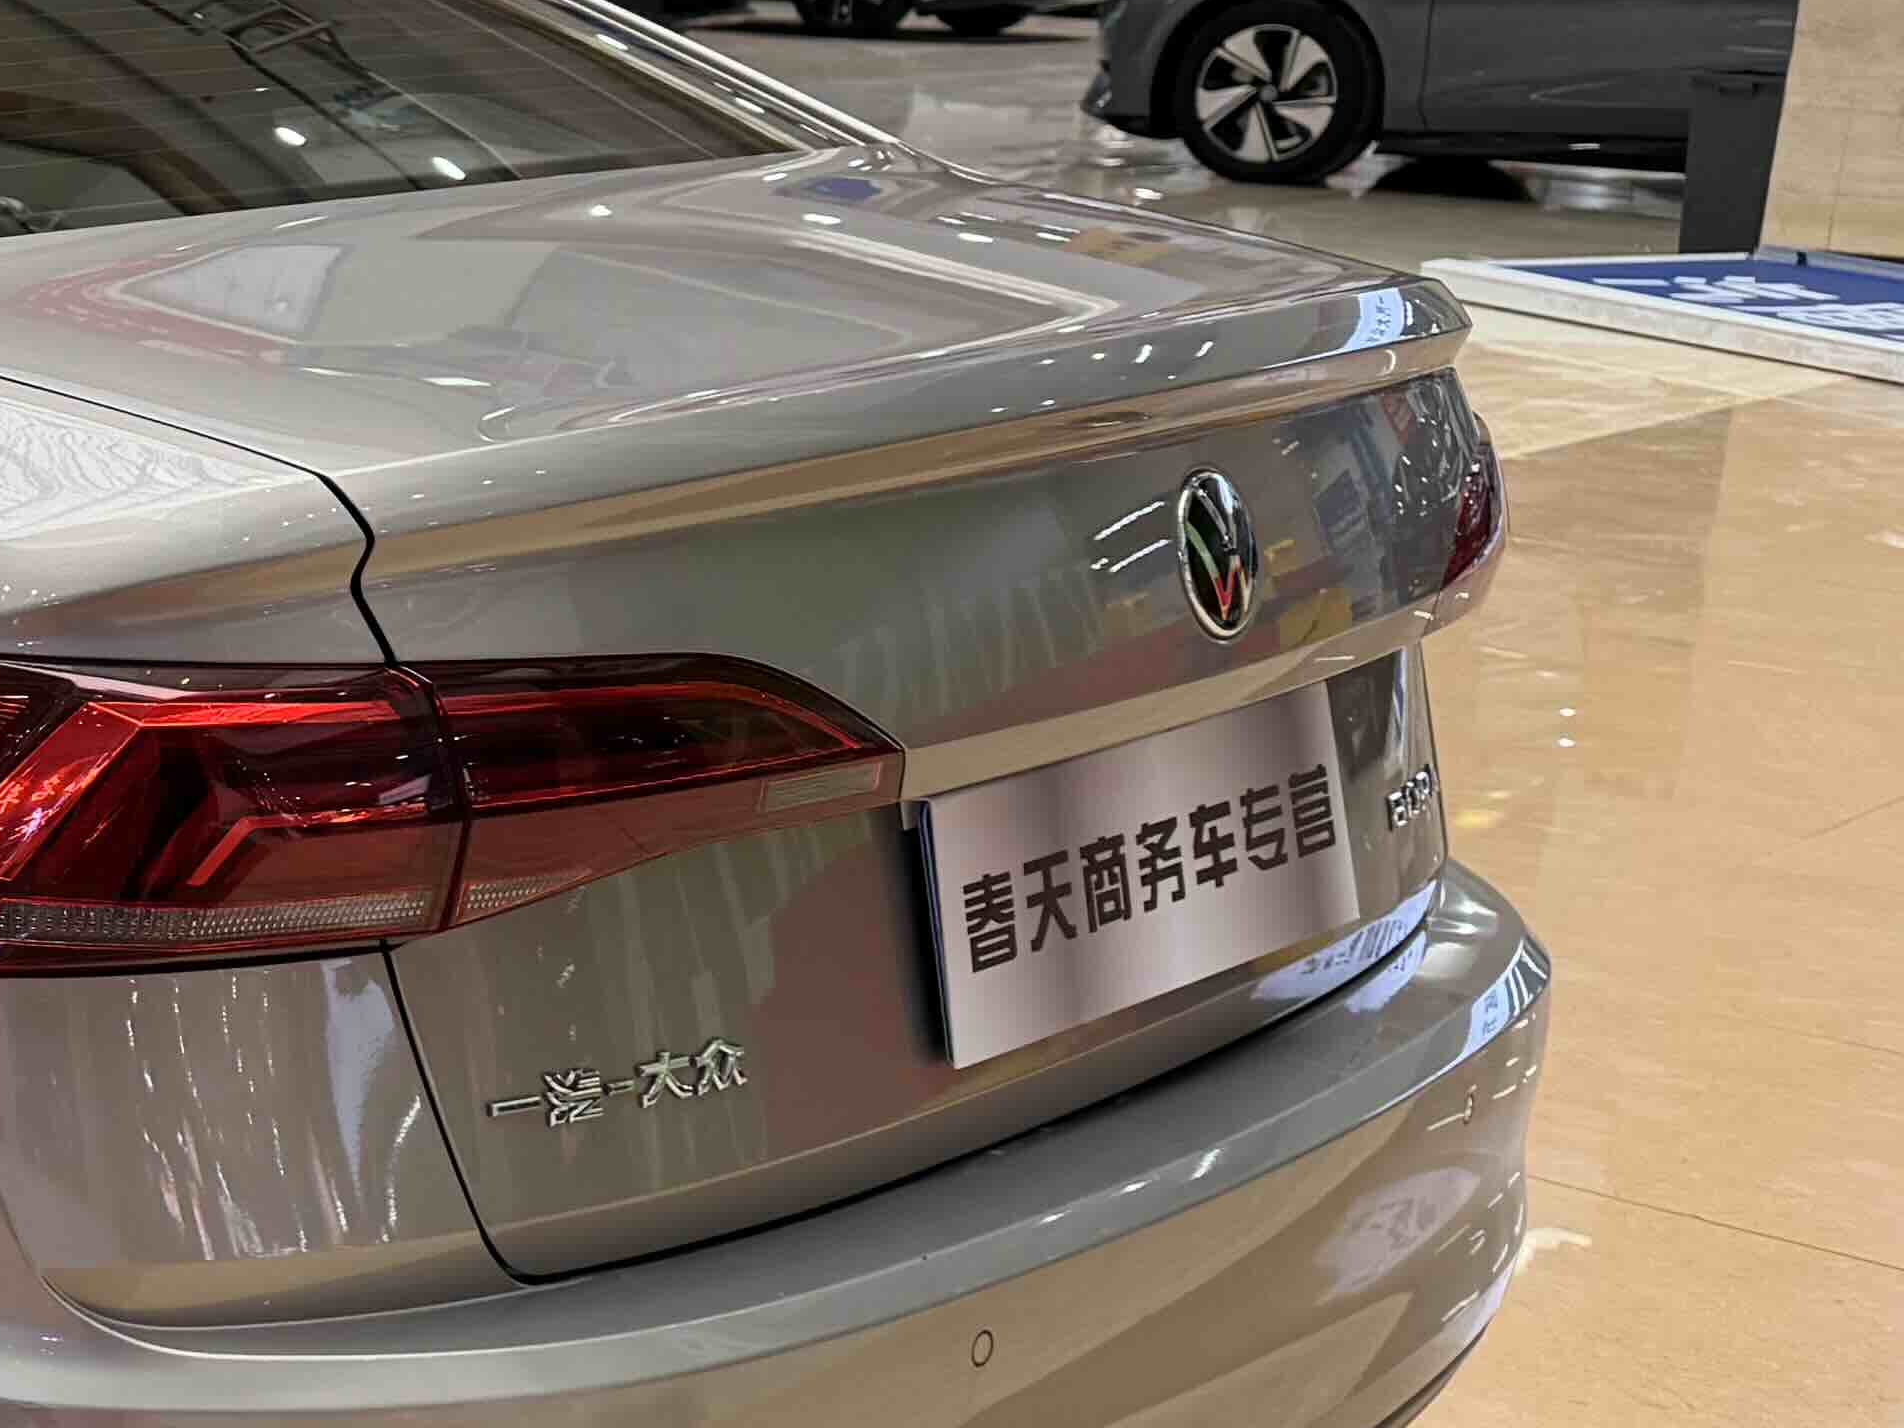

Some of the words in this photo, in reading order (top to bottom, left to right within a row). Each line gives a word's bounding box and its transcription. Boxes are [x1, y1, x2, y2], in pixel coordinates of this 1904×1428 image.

[962, 764, 1337, 973] 春天商务车专营
